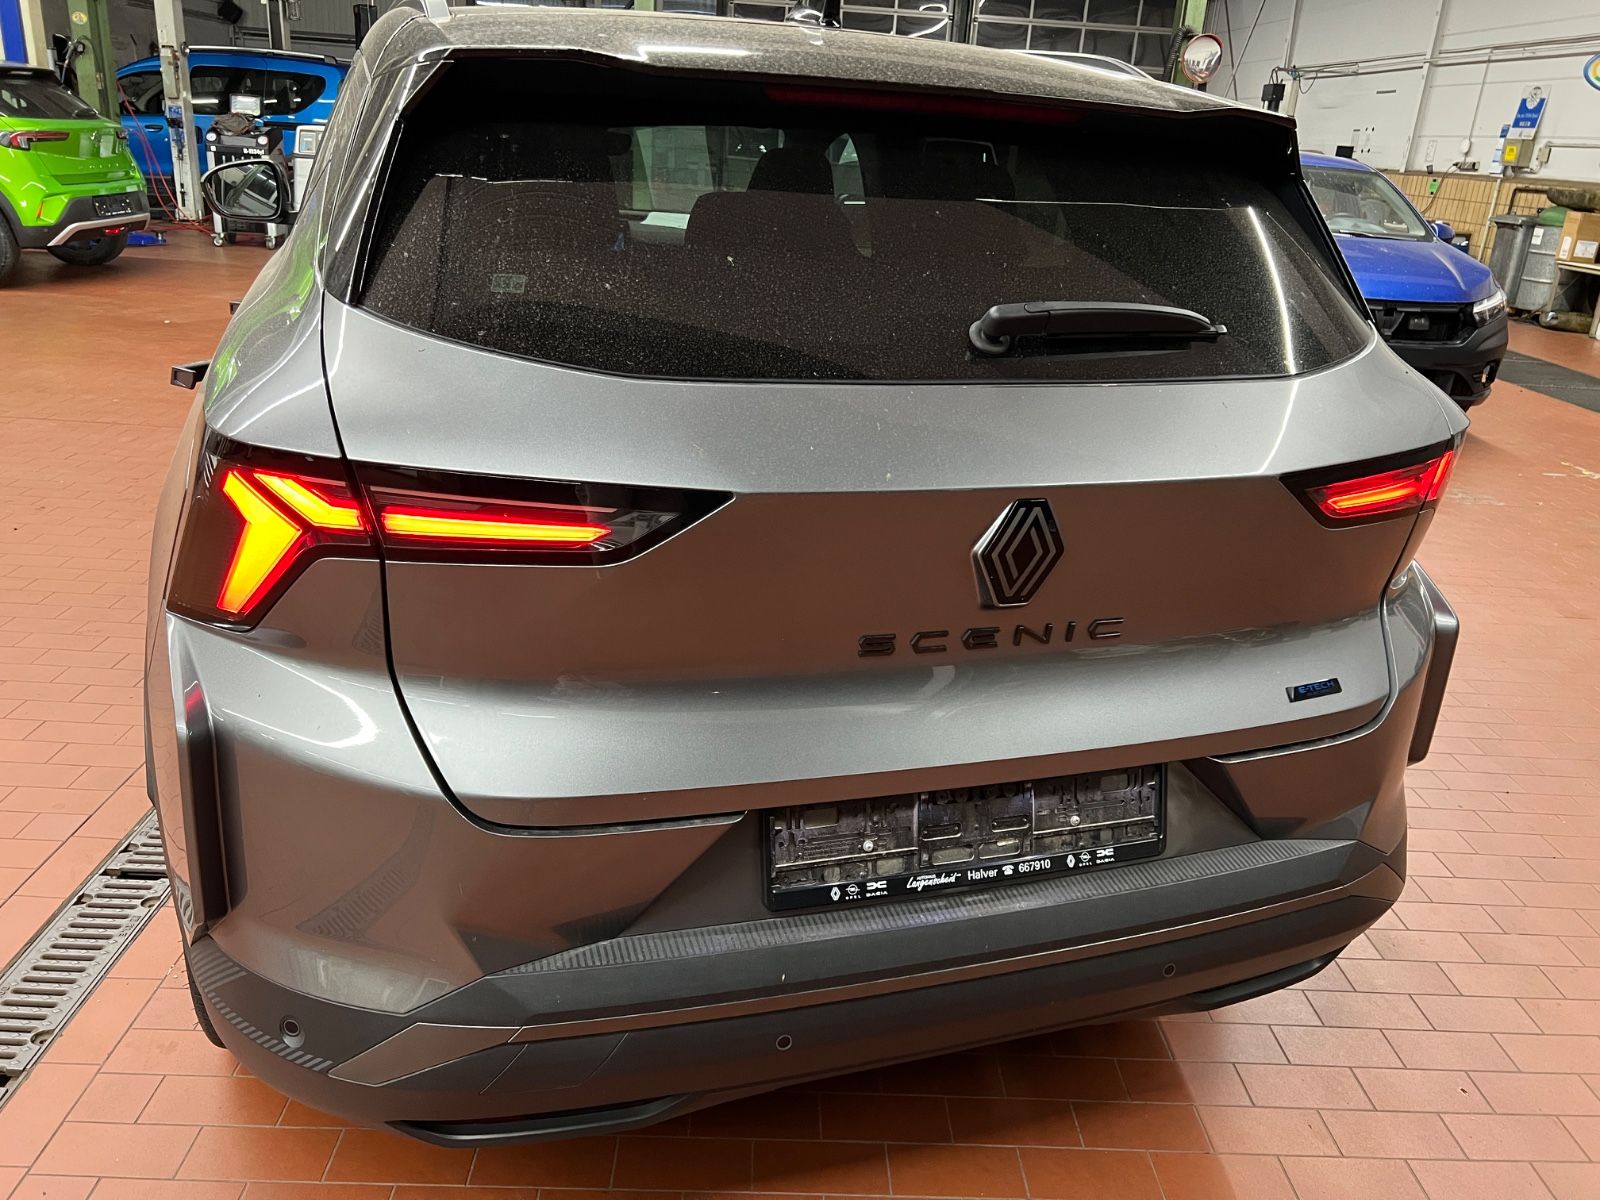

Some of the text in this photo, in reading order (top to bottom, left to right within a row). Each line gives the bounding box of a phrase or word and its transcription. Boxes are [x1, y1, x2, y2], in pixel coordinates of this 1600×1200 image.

[858, 617, 1124, 657] SCENIC
[1298, 680, 1335, 693] E-TECH
[967, 868, 998, 881] Halver
[1018, 859, 1051, 873] 667910
[866, 890, 888, 898] DACIA
